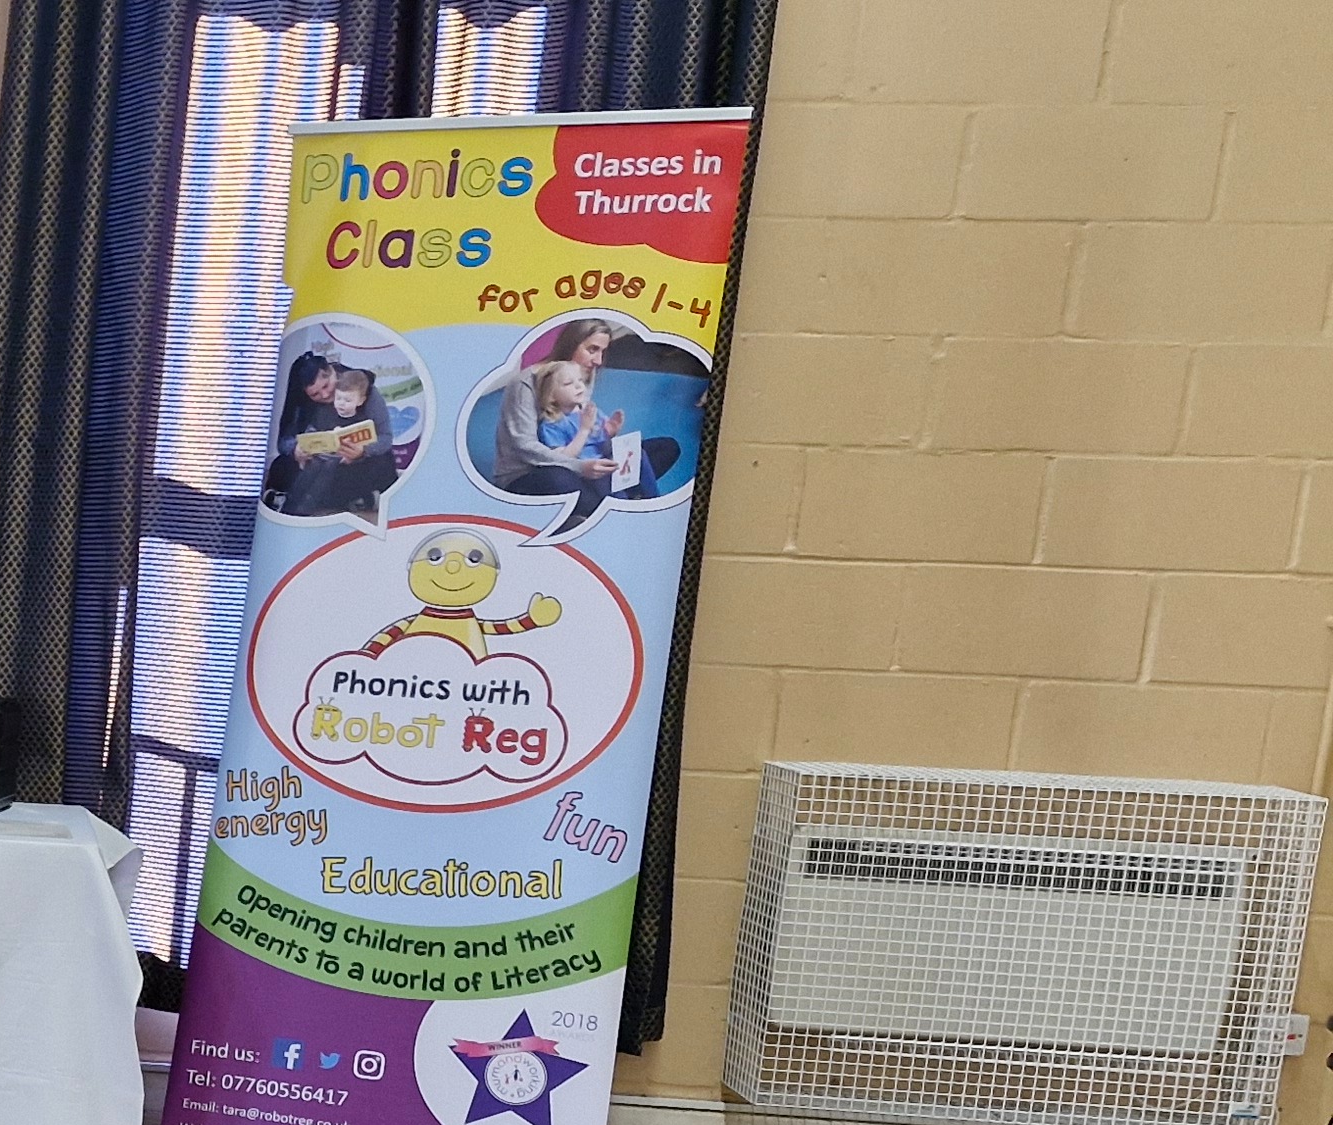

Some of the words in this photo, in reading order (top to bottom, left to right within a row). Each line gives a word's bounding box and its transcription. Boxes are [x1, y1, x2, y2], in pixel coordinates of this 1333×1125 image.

[574, 151, 684, 178] Classes
[693, 149, 722, 175] in
[574, 186, 713, 215] Thurrock
[326, 219, 492, 270] Class
[477, 284, 539, 313] for
[554, 269, 646, 300] ages
[651, 283, 712, 328] 1-4
[332, 669, 451, 700] Phonics
[462, 679, 530, 705] with
[310, 701, 445, 749] Robot
[462, 711, 548, 766] Reg
[226, 765, 302, 812] High
[214, 809, 328, 847] energy
[543, 791, 628, 864] fun
[320, 857, 564, 899] Educational
[237, 885, 338, 943] Opening
[343, 925, 445, 958] children
[454, 935, 508, 959] and
[514, 922, 575, 953] their
[211, 908, 309, 964] parents
[315, 949, 340, 975] to
[347, 962, 364, 981] a
[371, 967, 445, 992] world
[454, 972, 483, 993] of
[491, 950, 602, 991] Literacy
[551, 1011, 598, 1032] 2018
[191, 1039, 229, 1059] Find
[234, 1048, 261, 1064] us:
[488, 1041, 522, 1051] WINNER
[182, 1098, 219, 1113] Email:
[186, 1069, 216, 1088] Tel:
[221, 1073, 349, 1106] 07760556417
